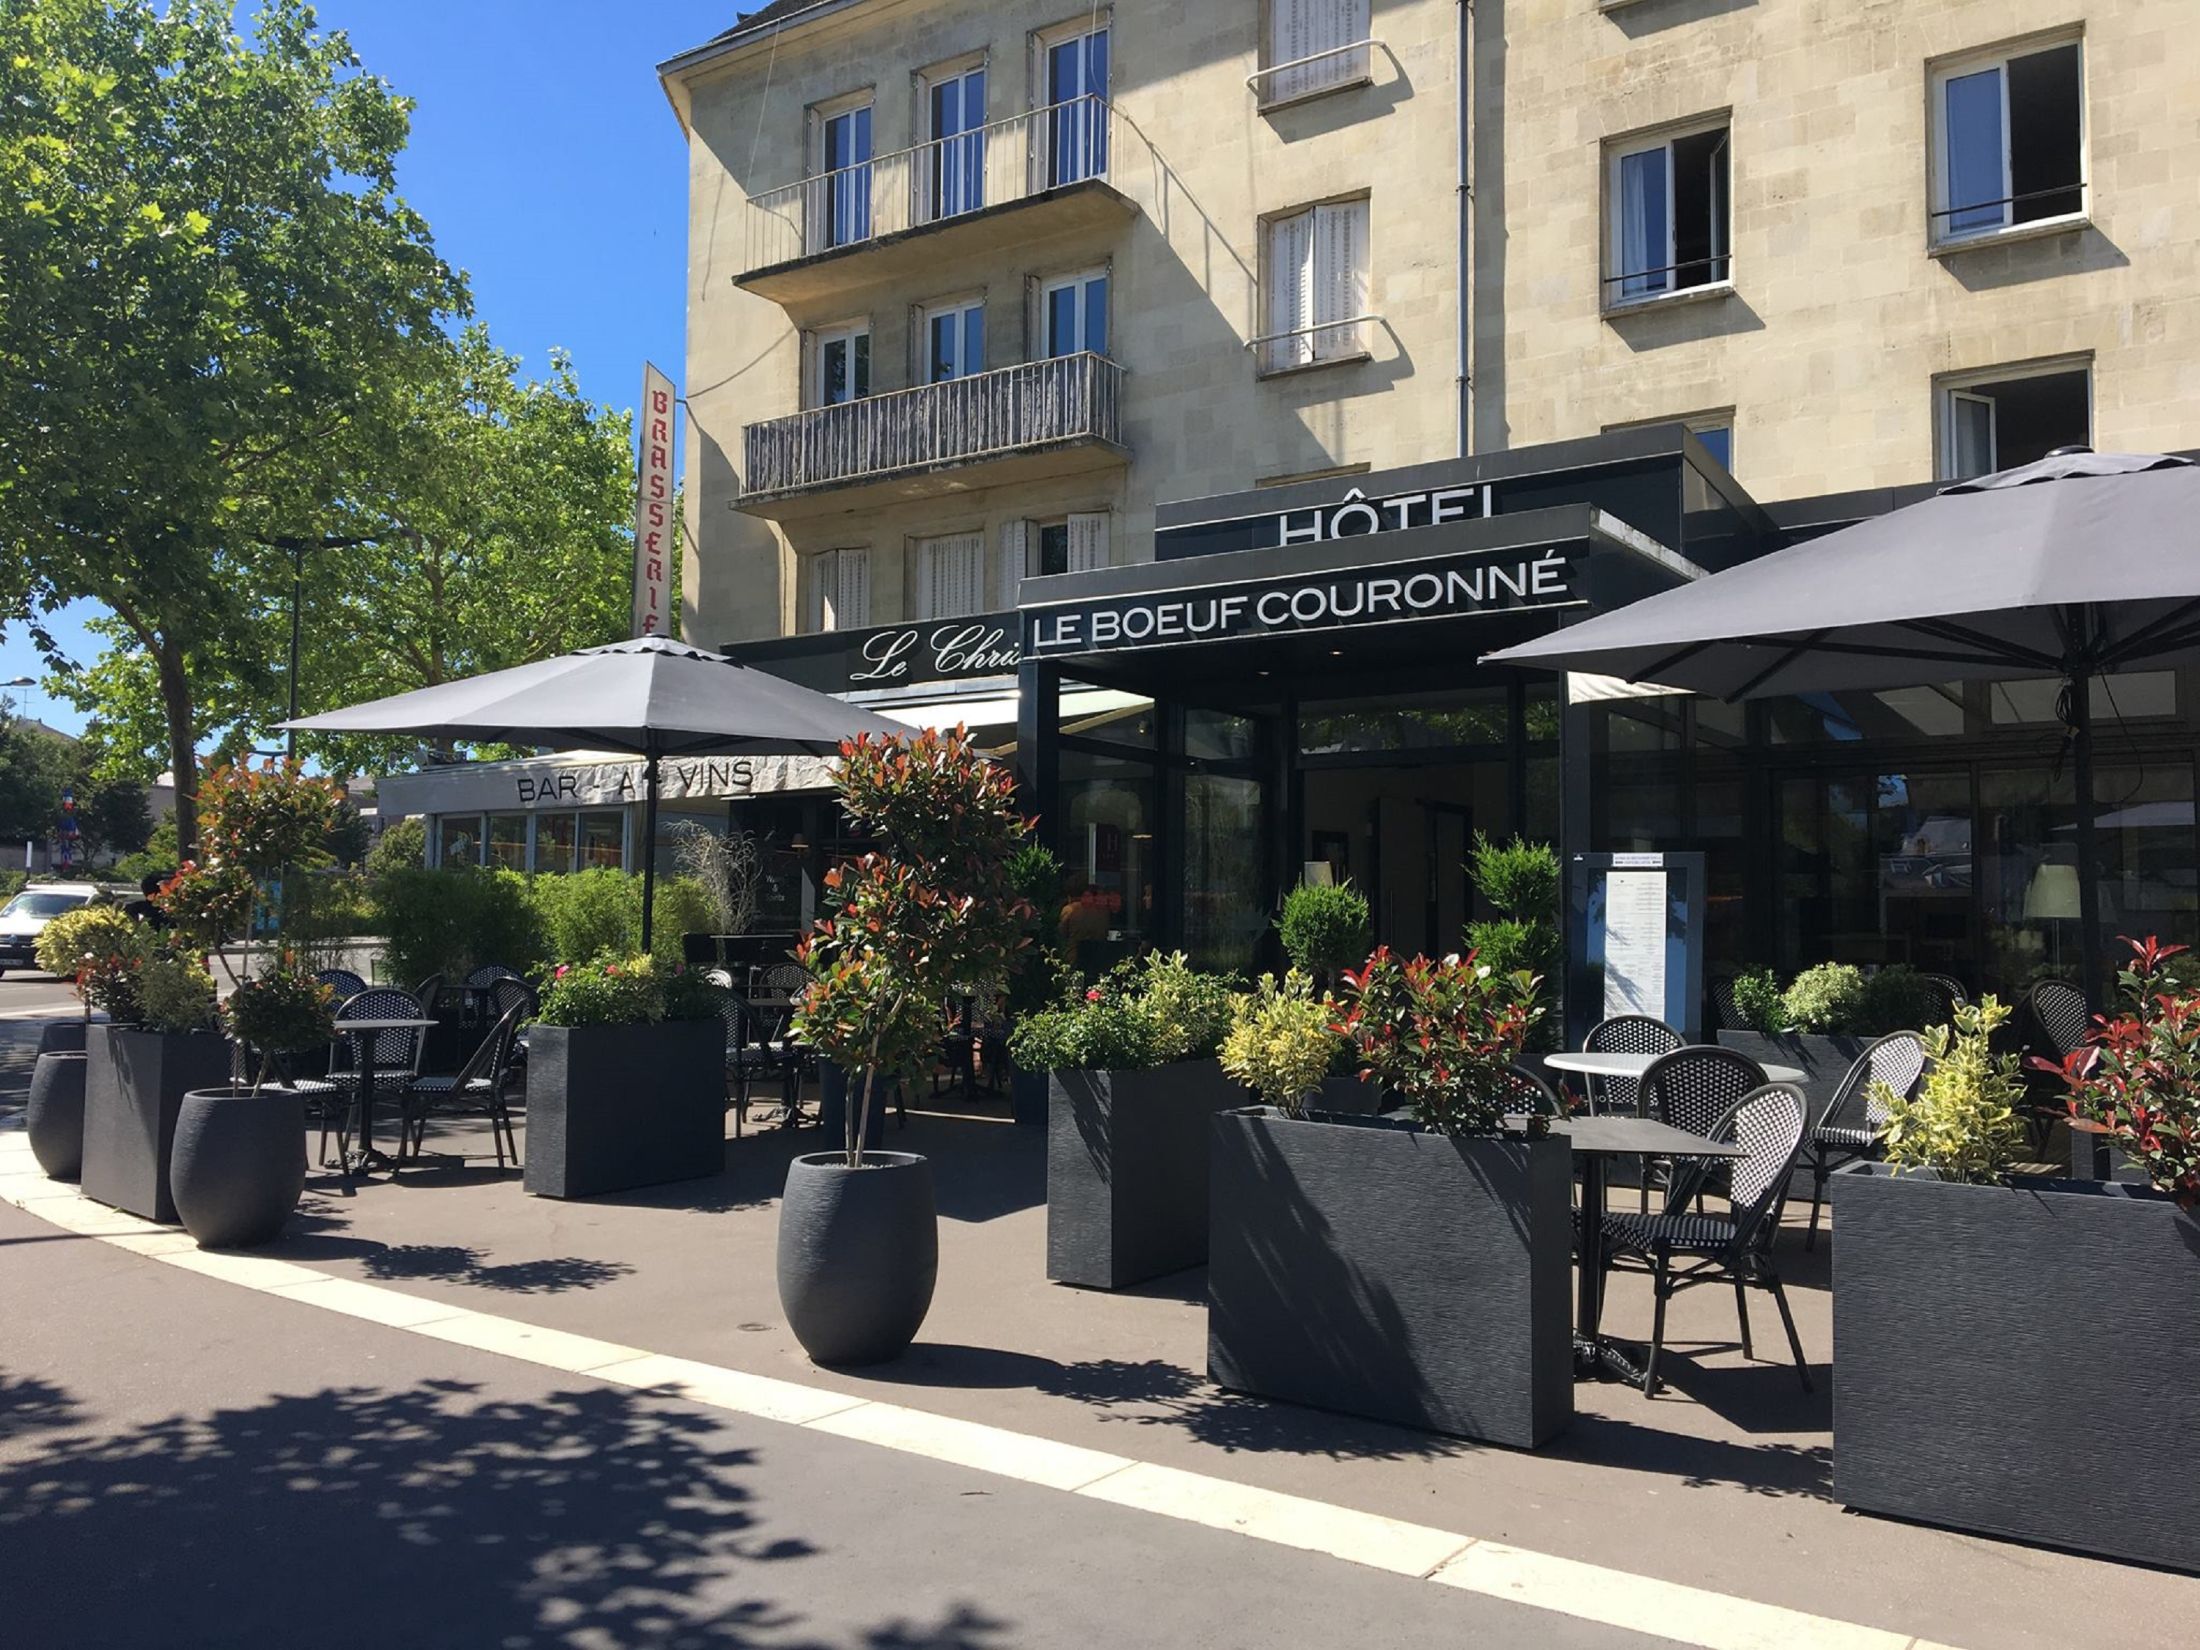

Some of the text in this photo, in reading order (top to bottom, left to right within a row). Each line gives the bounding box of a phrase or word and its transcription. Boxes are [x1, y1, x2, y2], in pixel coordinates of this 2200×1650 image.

[642, 390, 668, 634] BRASSERIE
[1033, 549, 1567, 647] LE BOEUF COURONNÉ
[850, 630, 918, 681] Le
[517, 776, 578, 802] BAR
[618, 771, 636, 796] A
[677, 761, 754, 790] VINS
